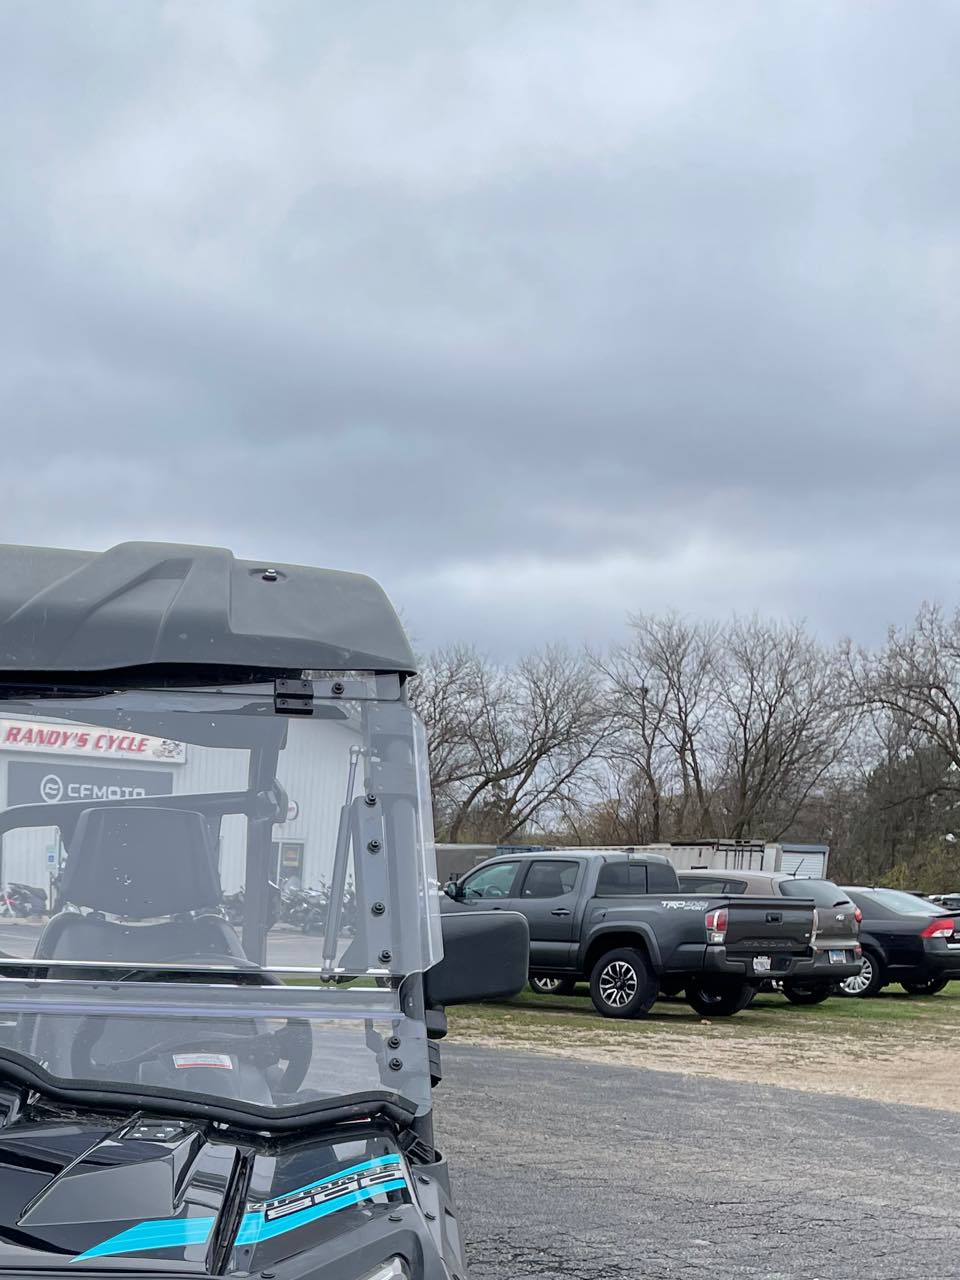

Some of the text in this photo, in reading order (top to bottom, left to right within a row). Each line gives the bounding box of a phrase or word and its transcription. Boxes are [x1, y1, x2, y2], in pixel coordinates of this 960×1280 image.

[5, 726, 150, 753] RANDY'S CYCLE
[67, 783, 145, 800] CFMOTO
